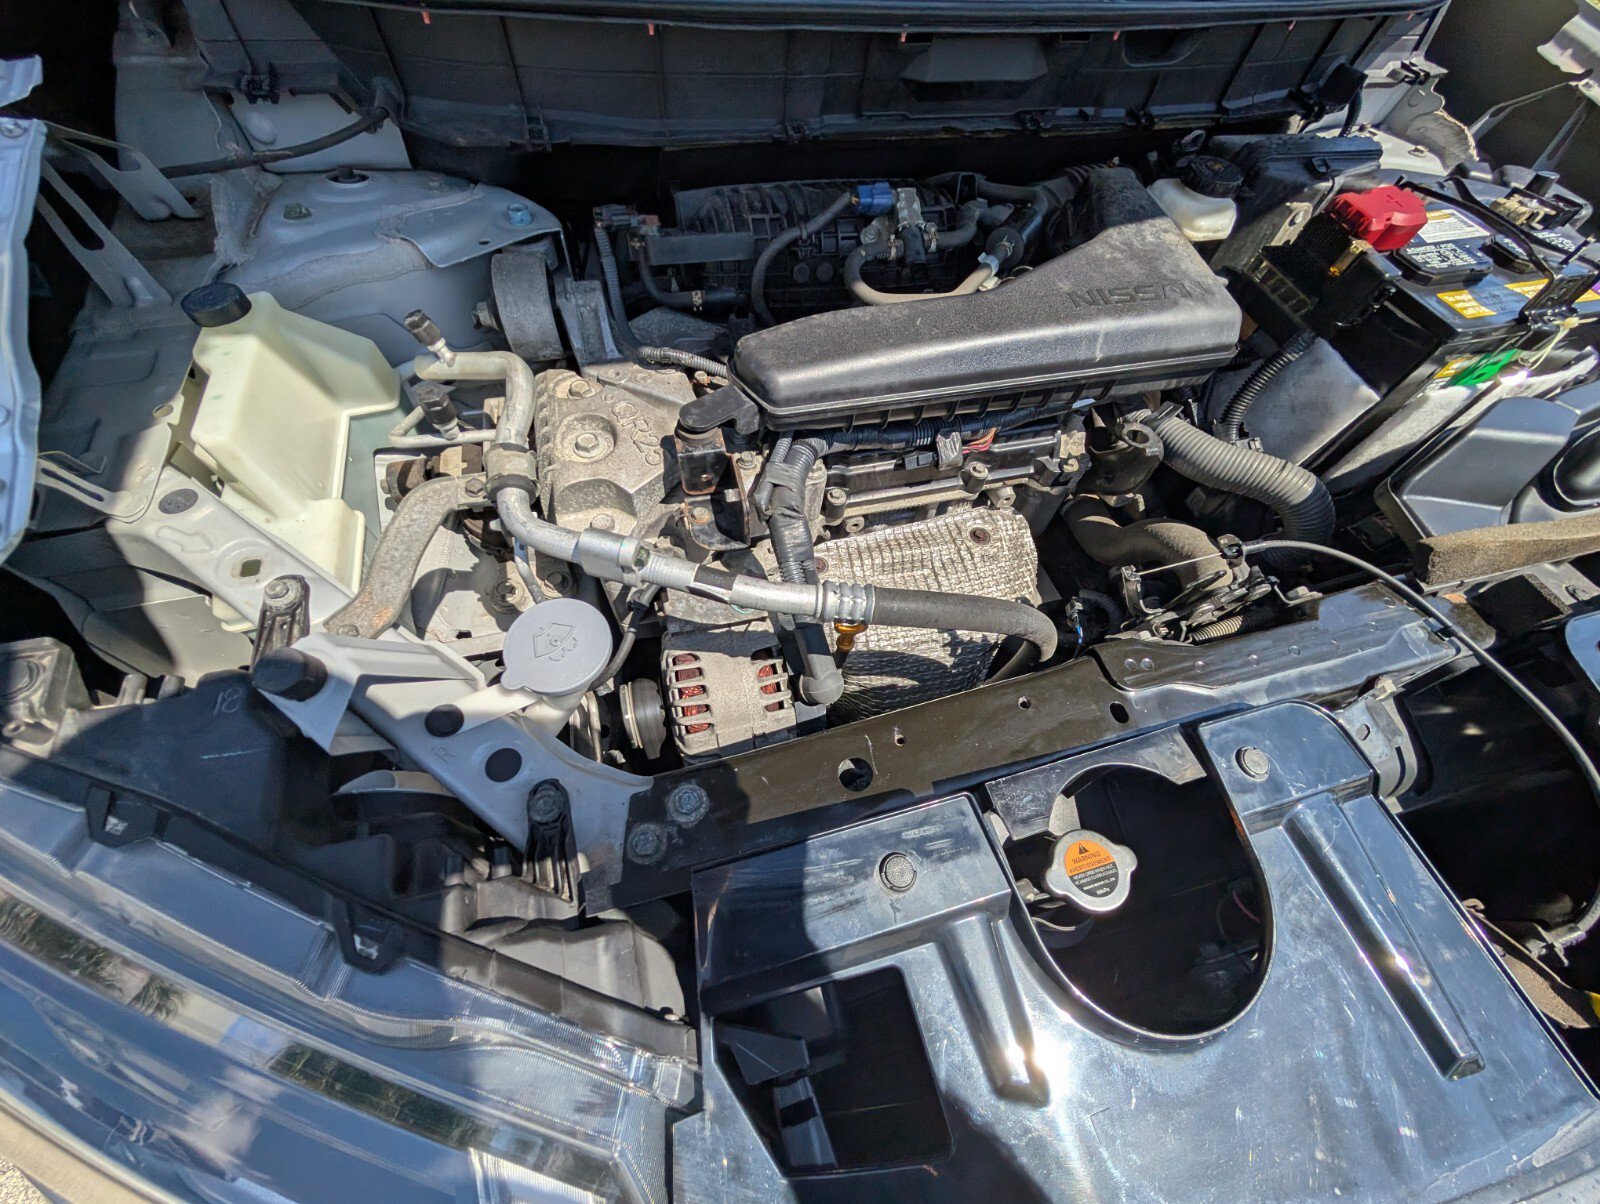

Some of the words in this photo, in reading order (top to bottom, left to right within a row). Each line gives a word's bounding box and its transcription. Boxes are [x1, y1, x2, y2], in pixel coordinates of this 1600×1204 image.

[1066, 281, 1209, 309] NISSAN
[612, 401, 664, 466] QR25
[1071, 851, 1101, 864] WARNING
